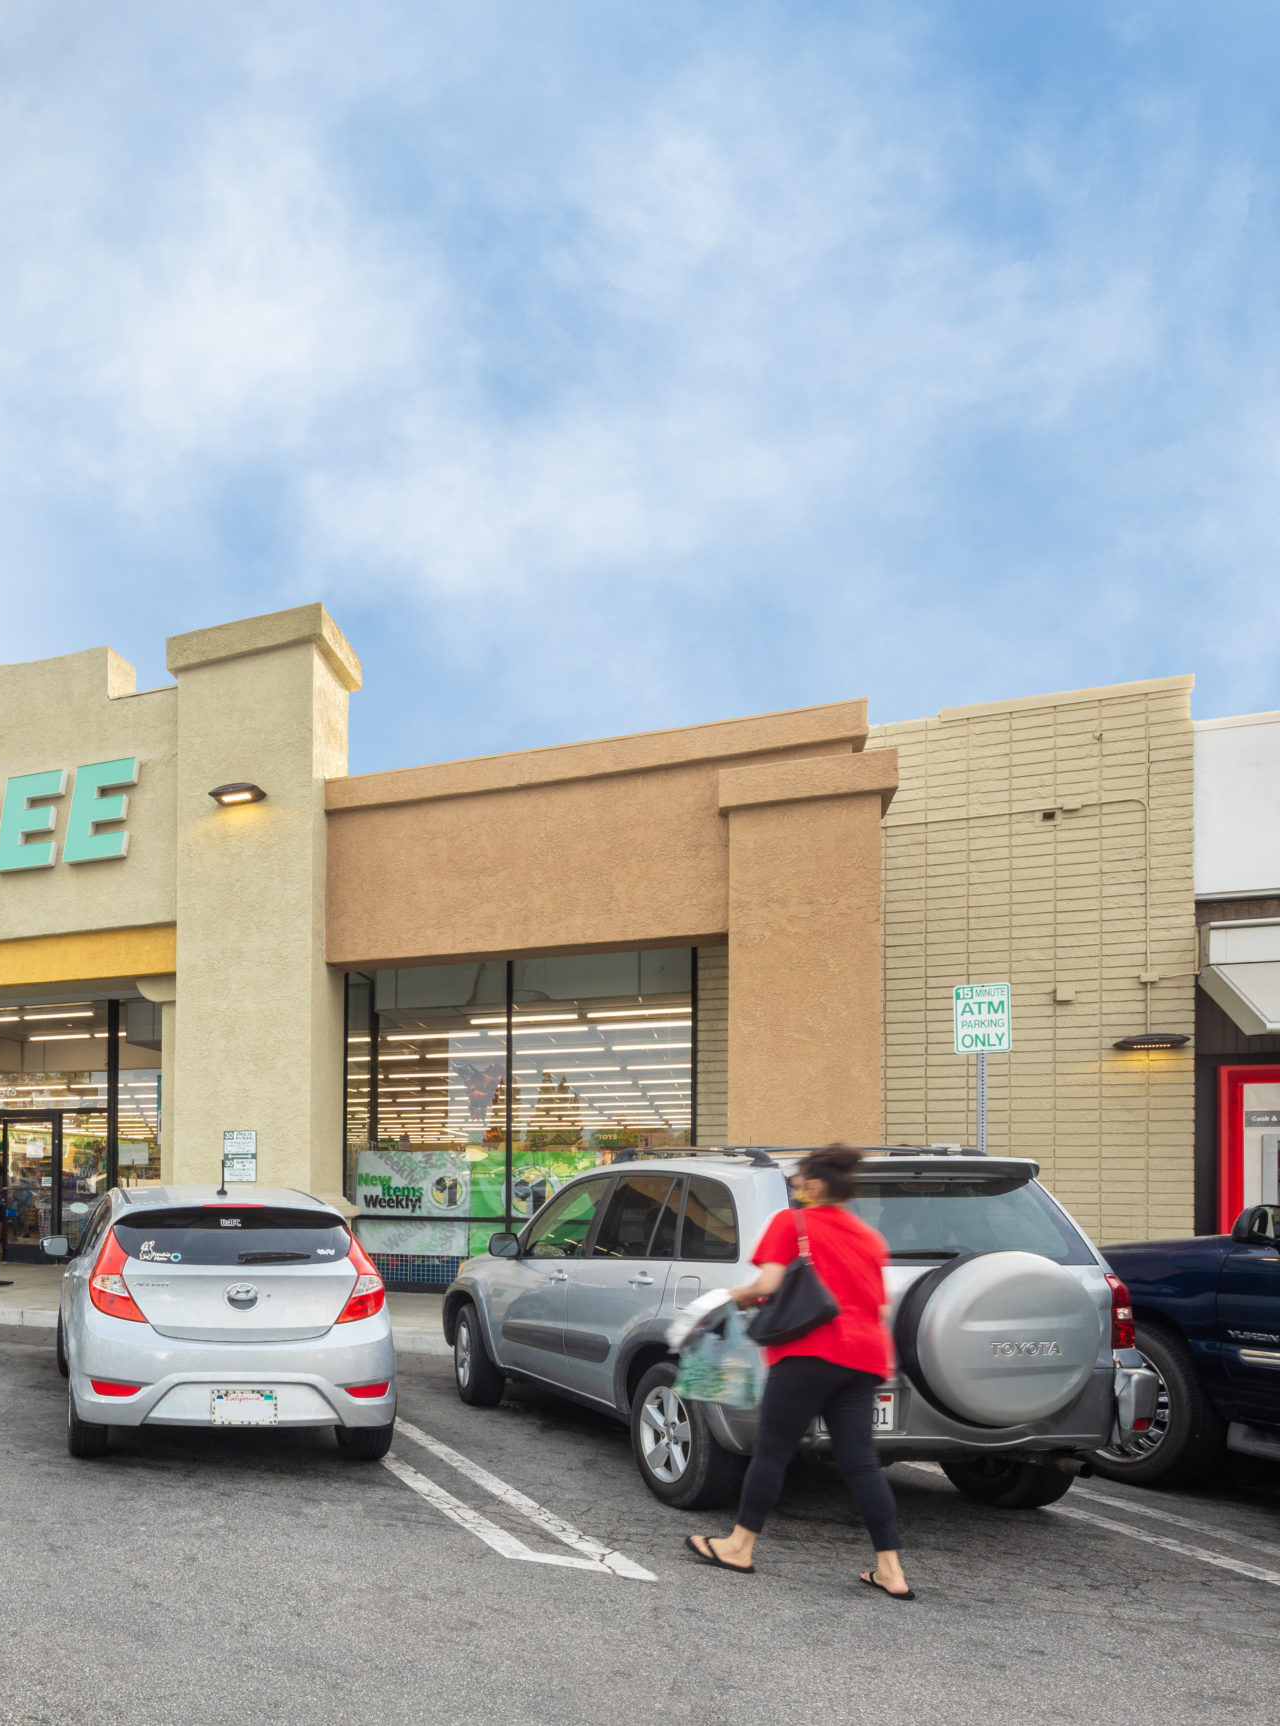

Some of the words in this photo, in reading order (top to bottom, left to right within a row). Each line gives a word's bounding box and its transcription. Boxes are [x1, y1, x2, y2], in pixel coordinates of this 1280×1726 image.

[958, 987, 973, 999] 15
[975, 986, 1006, 998] MINUTE
[960, 1000, 1005, 1016] ATM
[961, 1017, 1005, 1029] PARKING
[961, 1032, 1005, 1048] ONLY
[224, 1131, 234, 1140] 30
[224, 1160, 234, 1168] 30
[357, 1172, 393, 1187] New
[381, 1184, 424, 1198] Items
[363, 1194, 422, 1213] Weekly!
[1227, 1329, 1280, 1343] YUKON
[990, 1340, 1064, 1357] TOYOTA
[225, 1392, 262, 1403] California
